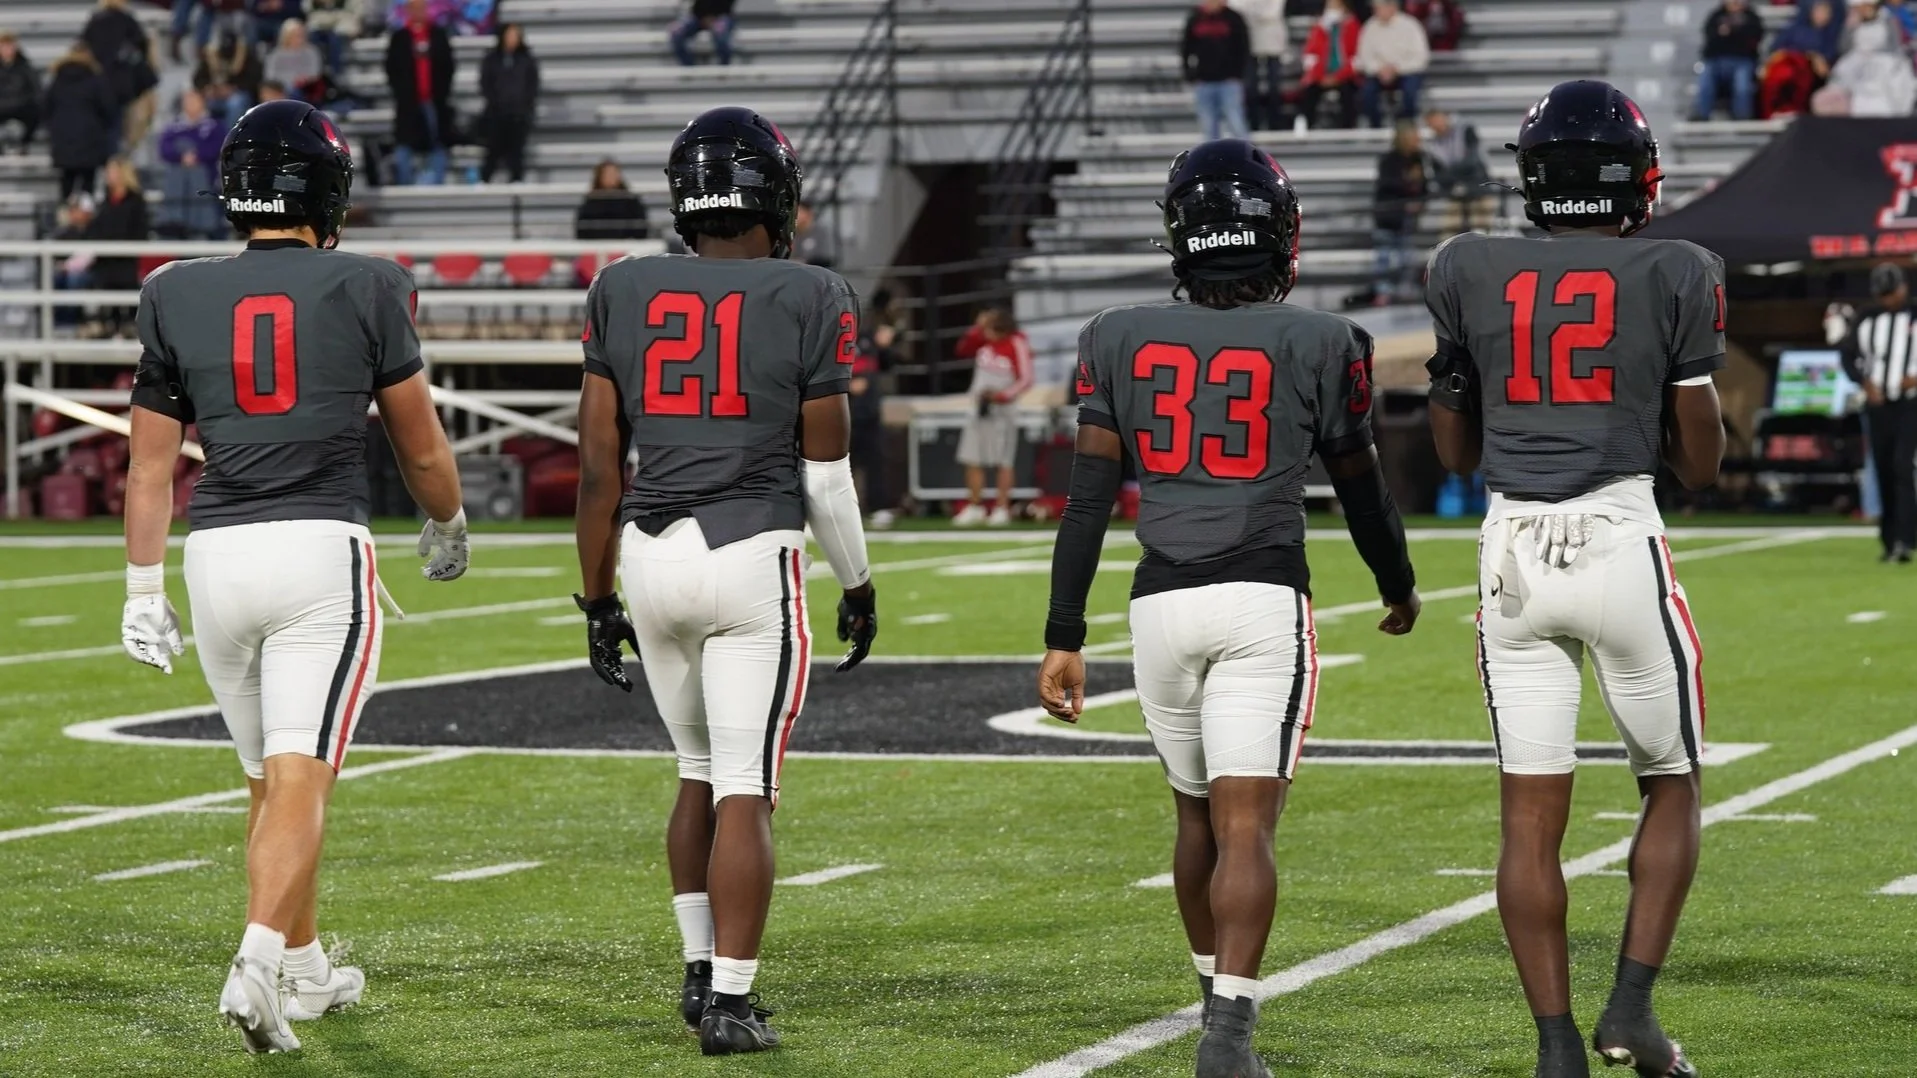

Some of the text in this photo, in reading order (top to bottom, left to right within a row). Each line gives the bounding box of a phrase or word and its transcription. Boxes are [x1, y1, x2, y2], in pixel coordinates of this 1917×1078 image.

[231, 198, 285, 213] Riddell
[684, 193, 743, 213] Riddell
[1541, 199, 1613, 215] Riddell
[1187, 230, 1256, 253] Riddell
[231, 293, 298, 415] 0
[643, 291, 748, 416] 21
[836, 312, 859, 364] 2
[1504, 270, 1617, 404] 12
[1132, 342, 1274, 479] 33
